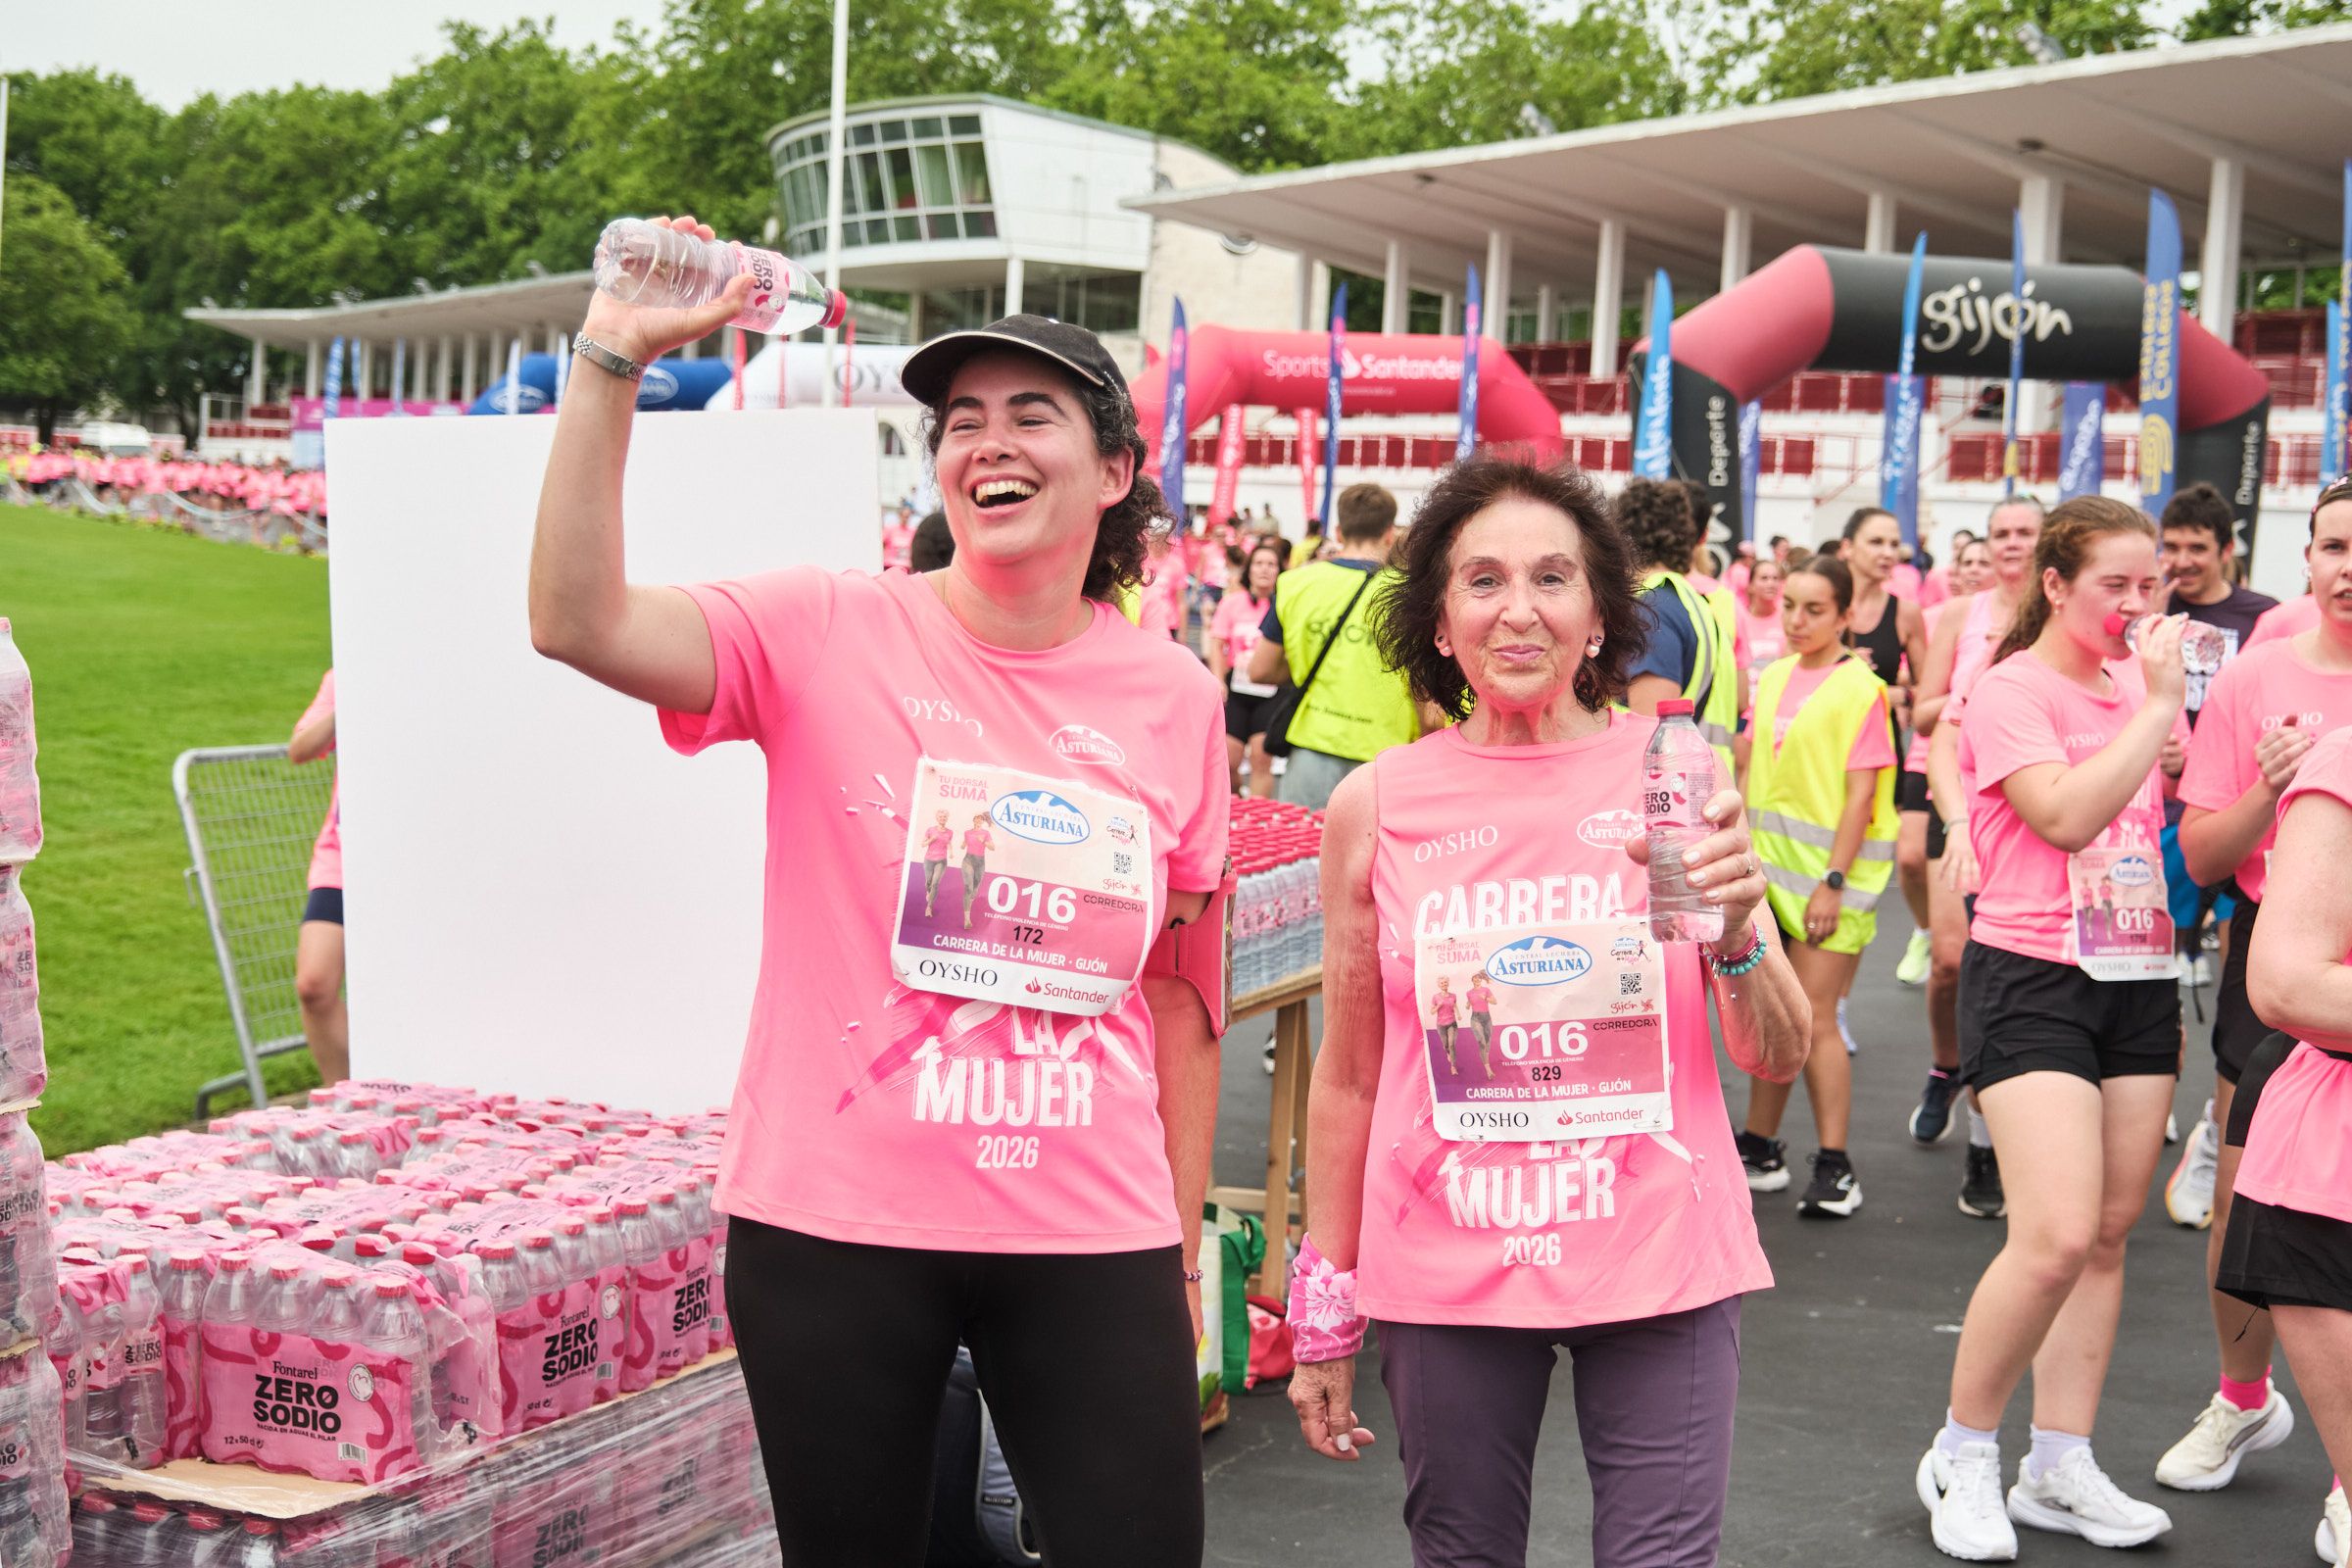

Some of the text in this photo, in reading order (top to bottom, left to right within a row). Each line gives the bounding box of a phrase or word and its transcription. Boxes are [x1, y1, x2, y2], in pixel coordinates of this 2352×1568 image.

[1922, 276, 2073, 356] gijón
[1263, 350, 1464, 382] Sports Santander
[1706, 395, 1731, 487] Deporte
[2235, 420, 2261, 505] Deporte
[939, 774, 988, 788] TU DORSAL
[939, 784, 989, 802] SUMA
[1643, 790, 1670, 806] ERO
[1000, 802, 1084, 837] ASTURIANA
[1414, 825, 1498, 863] OYSHO
[1102, 877, 1127, 891] gijón
[987, 876, 1076, 923] 016
[1083, 894, 1144, 913] CORREDORA
[1412, 872, 1628, 938] CARRERA
[2117, 907, 2154, 931] 016
[1013, 925, 1044, 945] 172
[934, 934, 1107, 973] CARRERA DE LA MUJER GIJÓN
[1437, 950, 1481, 964] SUMA
[1494, 956, 1586, 976] ASTURIANA
[919, 958, 998, 987] OYSHO
[1044, 983, 1109, 1004] Santander
[1610, 1000, 1638, 1014] gijón
[1012, 1006, 1060, 1055] LA
[1592, 1019, 1657, 1031] CORREDORA
[1499, 1021, 1589, 1060] 016
[1532, 1065, 1562, 1082] 829
[911, 1054, 1094, 1127] MUJER
[1466, 1078, 1632, 1100] CARRERA DE LA MUJER GIJÓN
[1460, 1111, 1529, 1128] OYSHO
[1576, 1108, 1644, 1124] Santander
[975, 1135, 1040, 1168] 2026
[1444, 1156, 1616, 1229] MUJER
[1501, 1233, 1561, 1266] 2026
[545, 1318, 598, 1359] ZERO
[272, 1360, 318, 1380] Fontarel
[542, 1342, 598, 1381] SODIO
[256, 1374, 338, 1409] ZERO
[253, 1400, 341, 1434] SODIO
[257, 1424, 278, 1433] NACIDA
[289, 1429, 309, 1438] AGUAS
[224, 1436, 233, 1445] 12
[239, 1437, 248, 1446] 50
